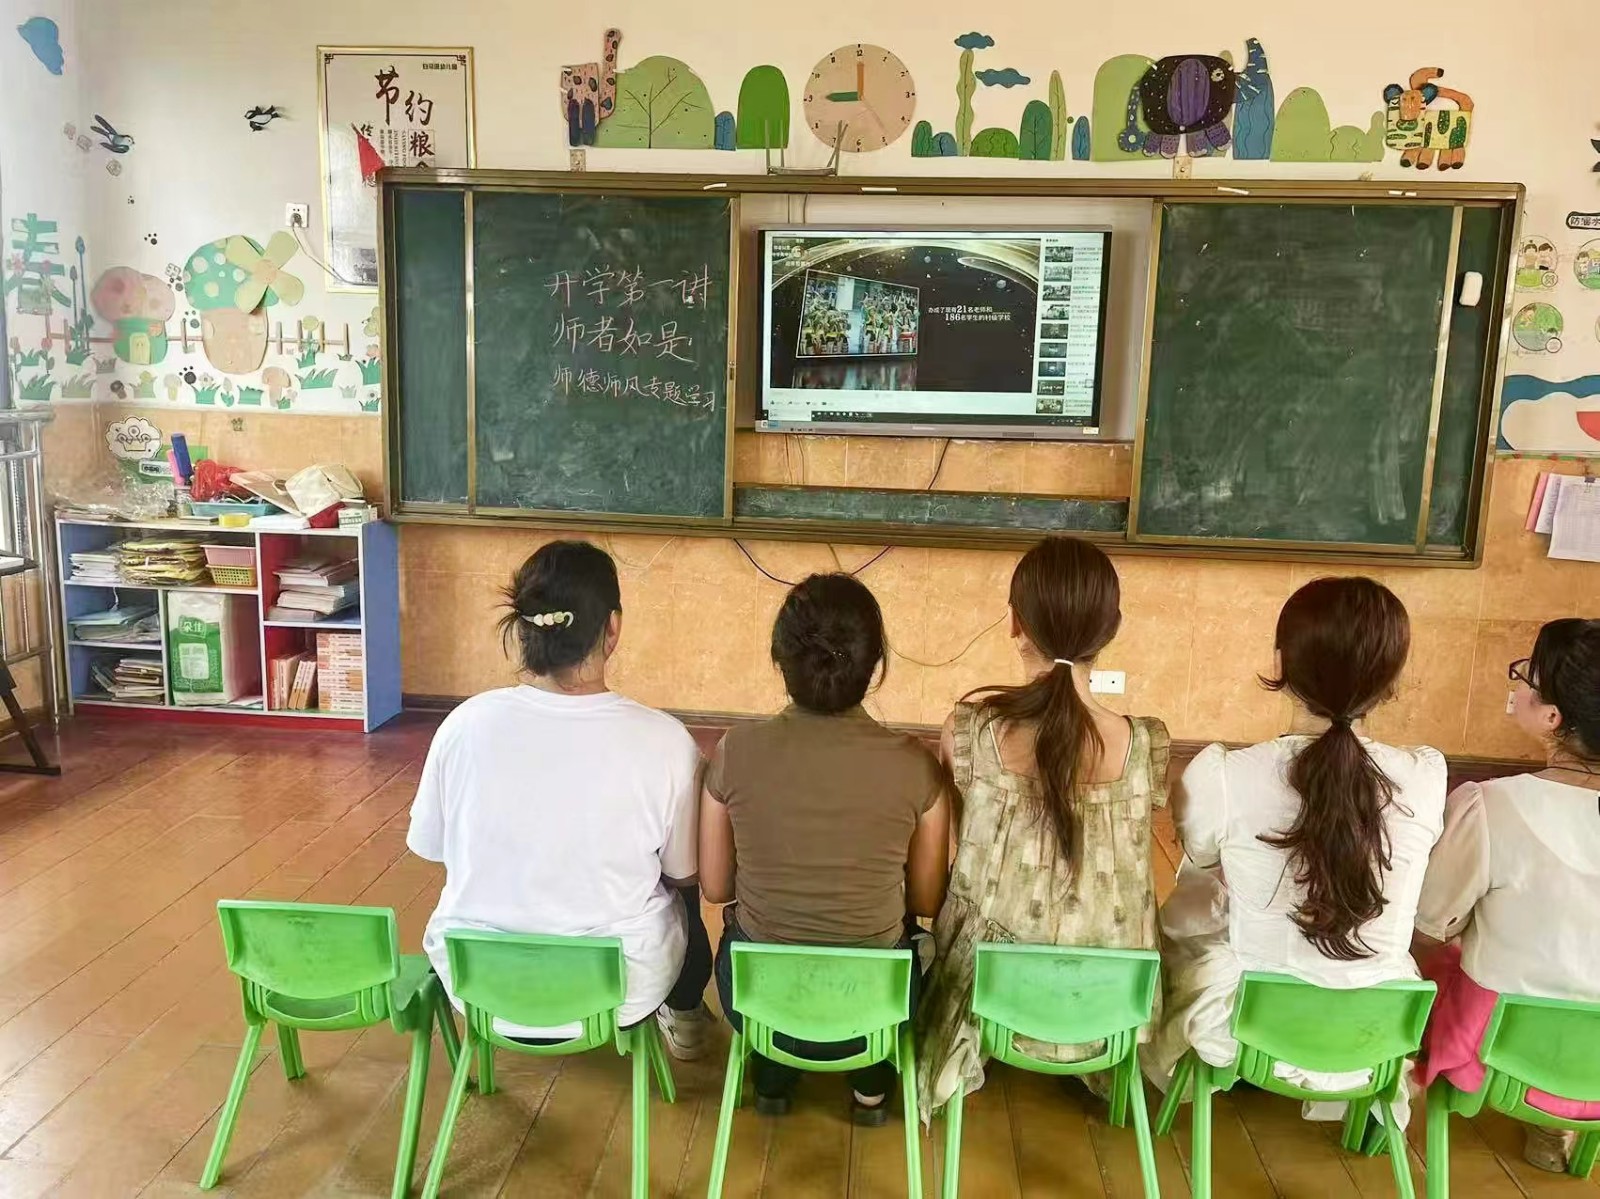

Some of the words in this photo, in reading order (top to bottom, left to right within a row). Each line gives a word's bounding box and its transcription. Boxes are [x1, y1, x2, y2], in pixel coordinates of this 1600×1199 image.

[856, 49, 863, 57] 12
[544, 263, 712, 310] 开学第一讲
[552, 313, 698, 364] 师者如是
[552, 362, 716, 412] 师德师风专题学习
